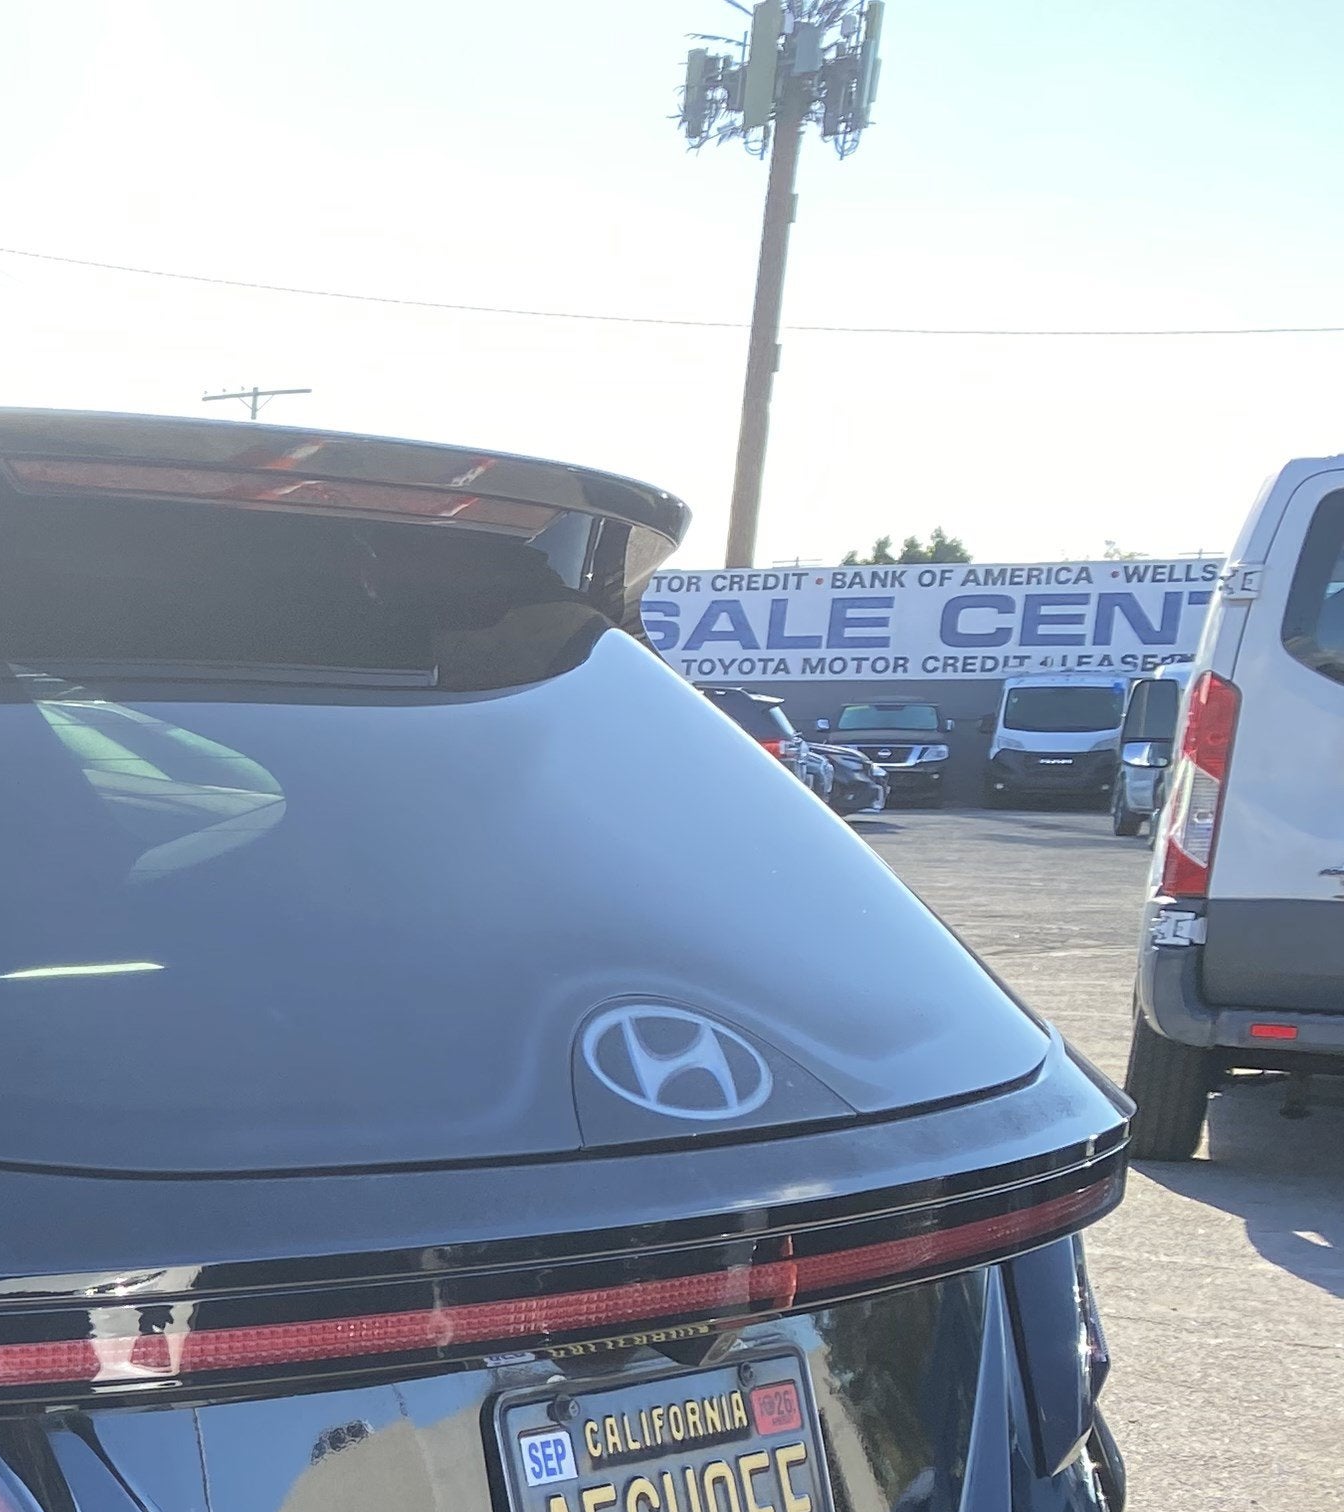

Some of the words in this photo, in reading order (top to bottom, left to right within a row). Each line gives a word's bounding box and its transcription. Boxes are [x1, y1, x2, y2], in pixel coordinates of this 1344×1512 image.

[711, 572, 809, 593] CREDIT
[830, 570, 907, 589] BANK
[917, 569, 954, 588] OF
[960, 566, 1093, 587] AMERICA
[1124, 563, 1218, 583] WELLS
[640, 596, 895, 650] SALE
[681, 657, 791, 676] TOYOTA
[801, 655, 910, 675] MOTOR
[921, 653, 1032, 674] CREDIT
[583, 1389, 749, 1459] CALIFORNIA
[526, 1436, 568, 1481] SEP
